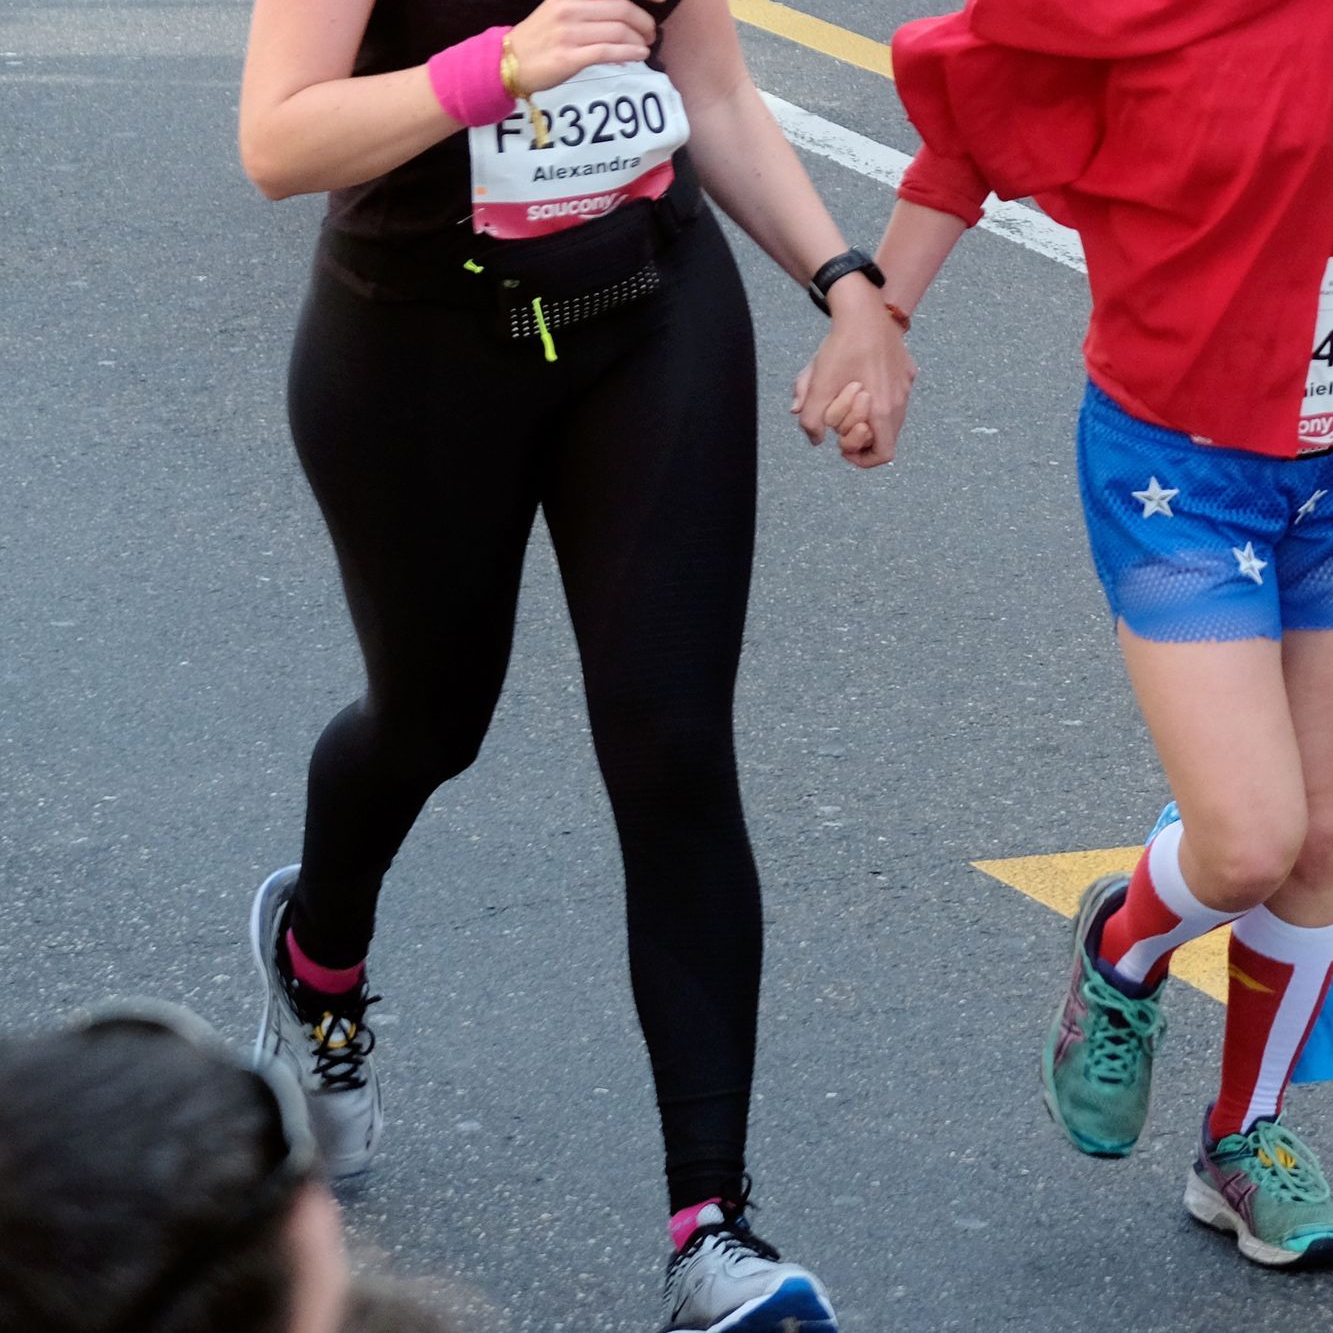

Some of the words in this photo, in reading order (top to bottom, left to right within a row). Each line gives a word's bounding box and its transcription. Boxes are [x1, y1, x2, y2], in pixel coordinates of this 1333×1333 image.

[495, 90, 666, 154] F23290
[532, 154, 642, 183] Alexandra
[526, 193, 619, 222] saucony
